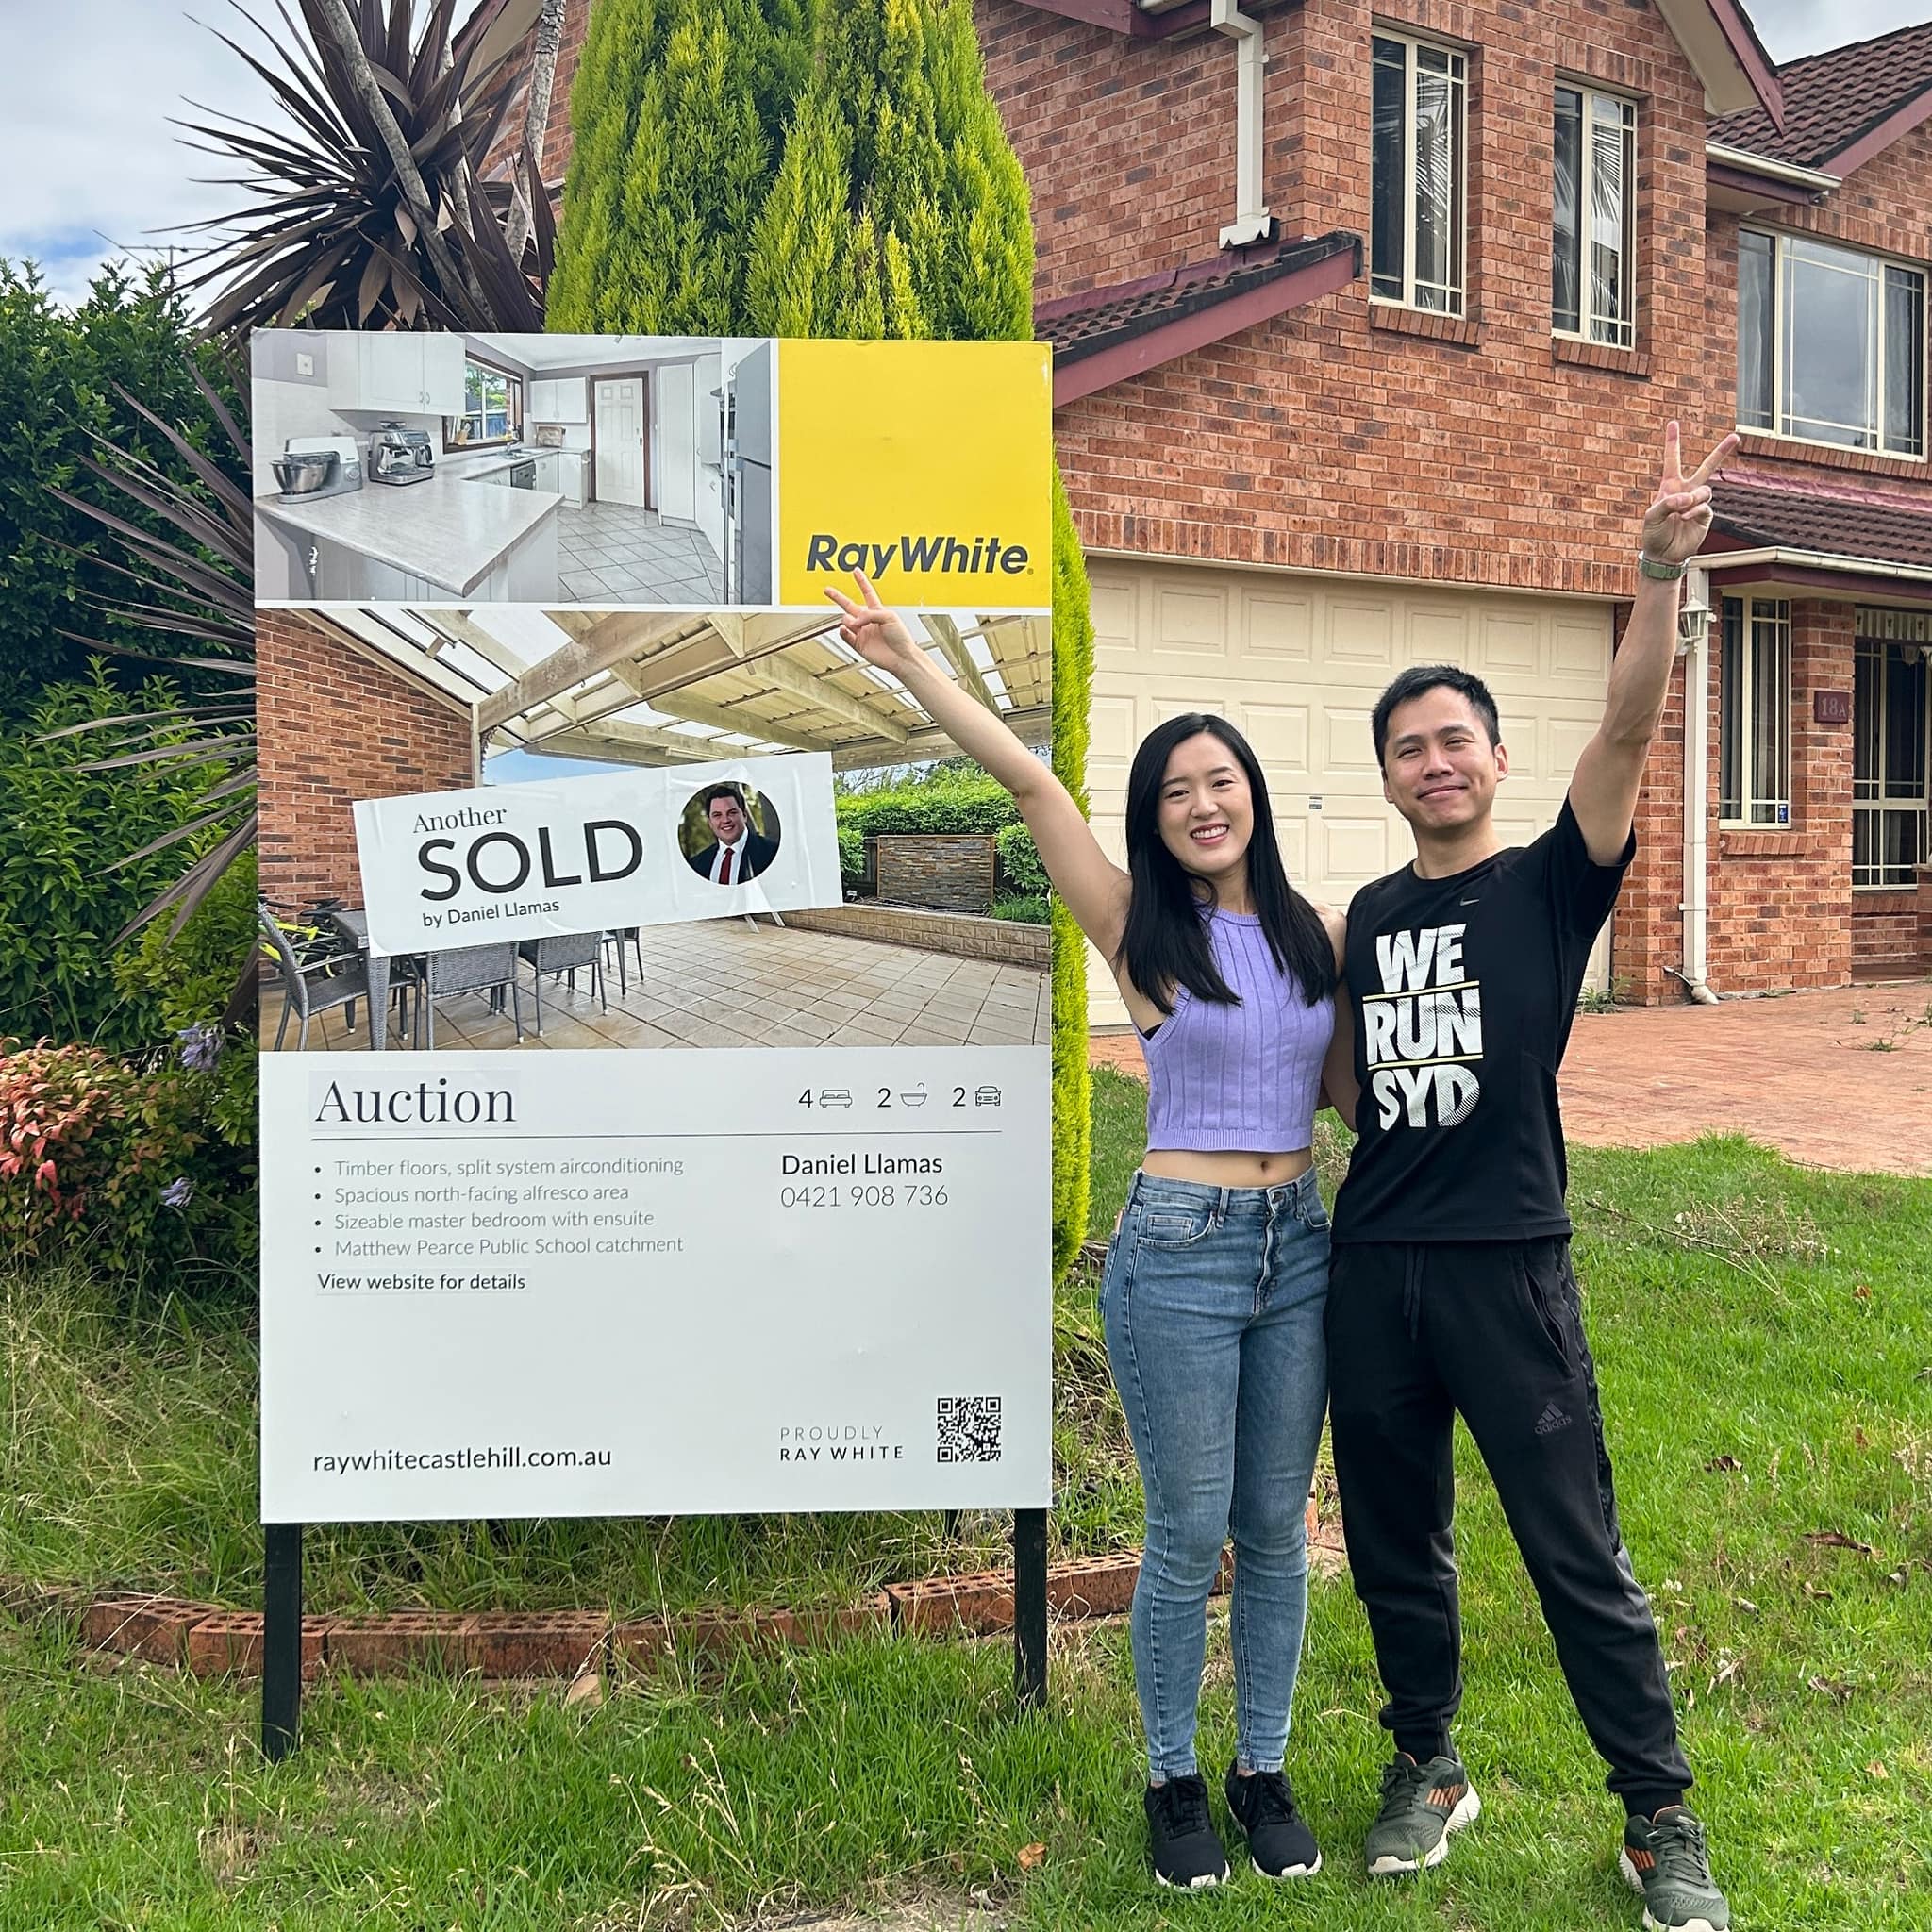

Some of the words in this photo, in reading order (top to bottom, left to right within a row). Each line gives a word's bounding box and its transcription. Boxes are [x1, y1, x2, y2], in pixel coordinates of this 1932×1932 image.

[1821, 696, 1847, 718] 18A
[413, 807, 507, 834] Another
[418, 820, 643, 902] SOLD
[423, 912, 442, 928] by
[447, 904, 500, 924] Daniel
[505, 899, 560, 918] Llamas
[1375, 923, 1468, 994] WE
[1362, 988, 1483, 1065] RUN
[314, 1077, 518, 1124] Auction
[798, 1088, 814, 1108] 4
[876, 1087, 891, 1108] 2
[952, 1086, 966, 1108] 2
[1372, 1063, 1480, 1132] SYD
[334, 1160, 394, 1176] Timber
[400, 1159, 452, 1177] floors,
[457, 1158, 491, 1177] split
[496, 1159, 555, 1177] system
[560, 1158, 684, 1176] airconditioning
[782, 1153, 856, 1175] Daniel
[864, 1153, 942, 1174] Llamas
[335, 1187, 409, 1206] Spacious
[415, 1186, 518, 1205] north-facing
[523, 1185, 589, 1201] alfresco
[593, 1188, 629, 1200] area
[780, 1185, 841, 1208] 0421
[851, 1184, 895, 1207] 908
[904, 1184, 949, 1206] 736
[335, 1213, 404, 1230] Sizeable
[409, 1214, 466, 1228] master
[471, 1212, 547, 1228] bedroom
[552, 1210, 589, 1226] with
[593, 1210, 655, 1226] ensuite
[335, 1240, 411, 1257] Matthew
[417, 1239, 474, 1256] Pearce
[479, 1238, 530, 1255] Public
[535, 1237, 591, 1254] School
[595, 1236, 684, 1253] catchment
[317, 1273, 361, 1290] View
[366, 1272, 435, 1290] website
[440, 1273, 465, 1290] for
[469, 1273, 526, 1290] details
[780, 1425, 883, 1441] PROUDLY
[1534, 1415, 1573, 1435] adidas
[313, 1446, 612, 1475] raywhitecastlehill.com.au
[780, 1446, 821, 1461] RAY
[830, 1445, 903, 1460] WHITE
